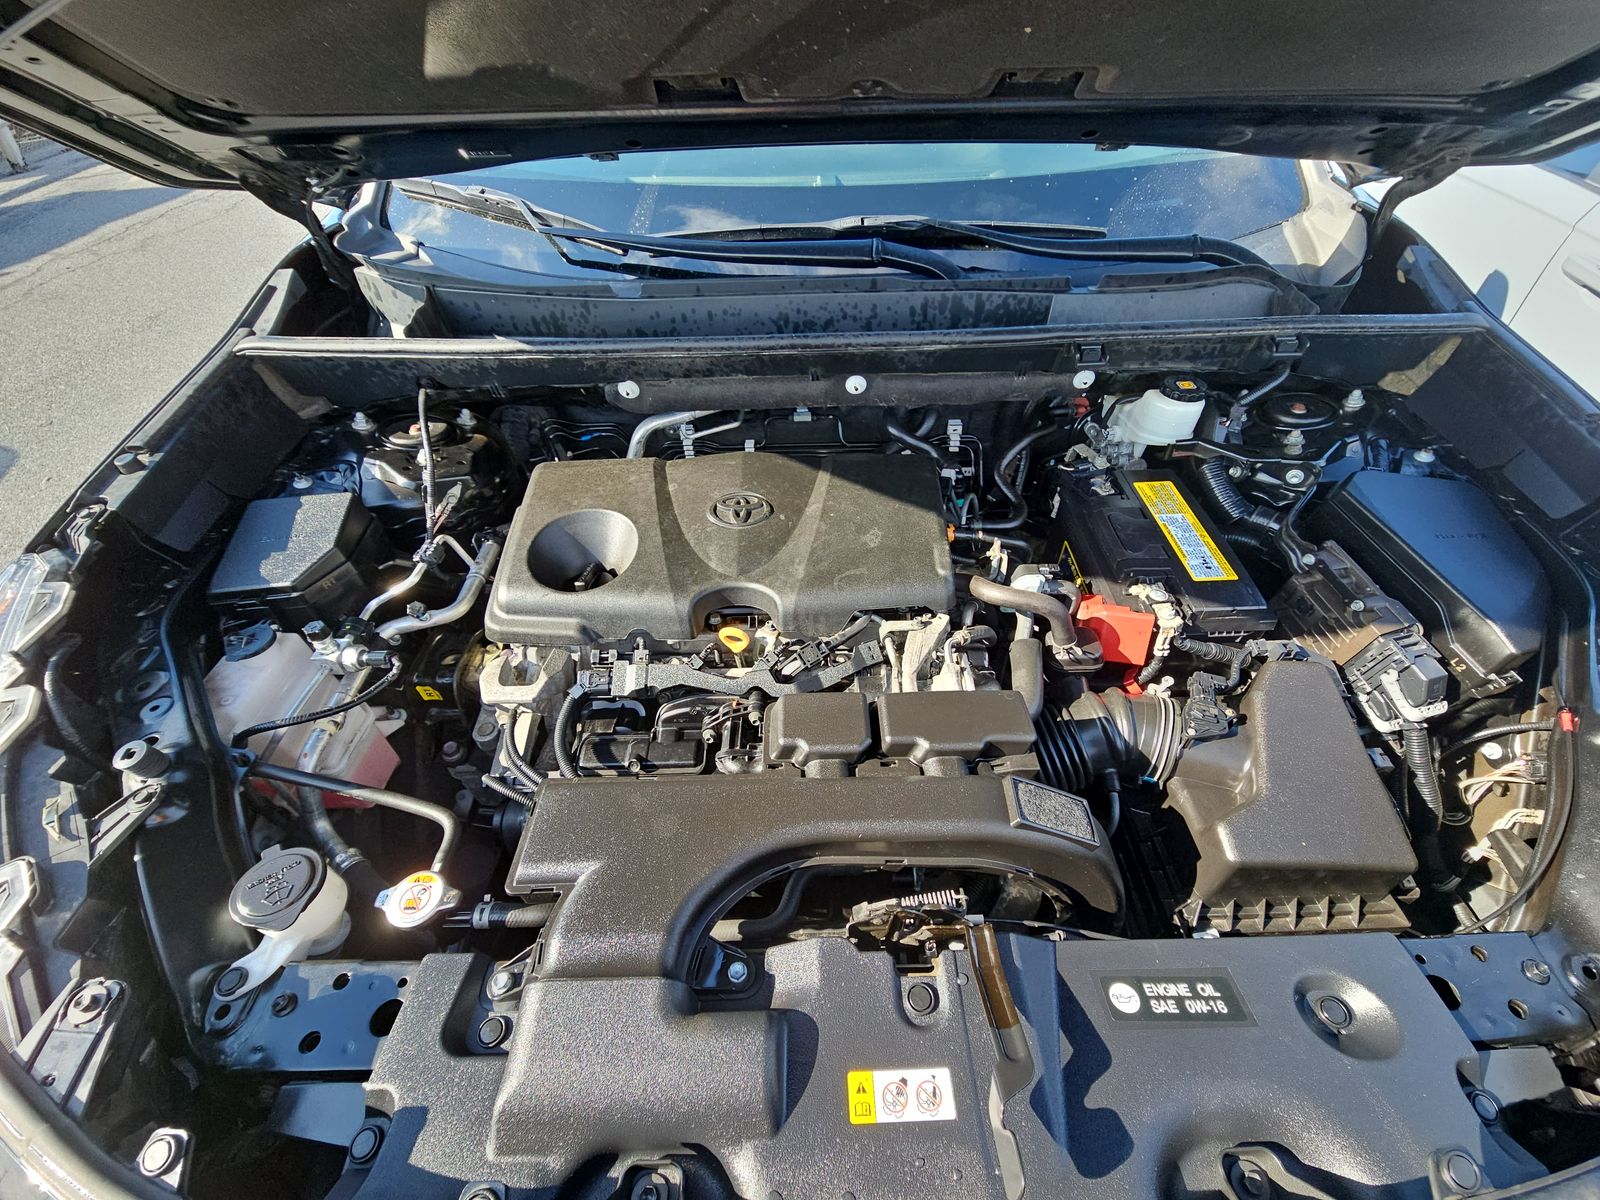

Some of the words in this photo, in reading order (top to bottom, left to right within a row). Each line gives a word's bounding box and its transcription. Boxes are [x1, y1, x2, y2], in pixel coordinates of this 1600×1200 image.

[1450, 657, 1467, 672] L2
[1142, 982, 1193, 997] ENGINE
[1196, 982, 1222, 997] OIL
[1150, 999, 1180, 1014] SAE
[1184, 999, 1229, 1014] 0W-16
